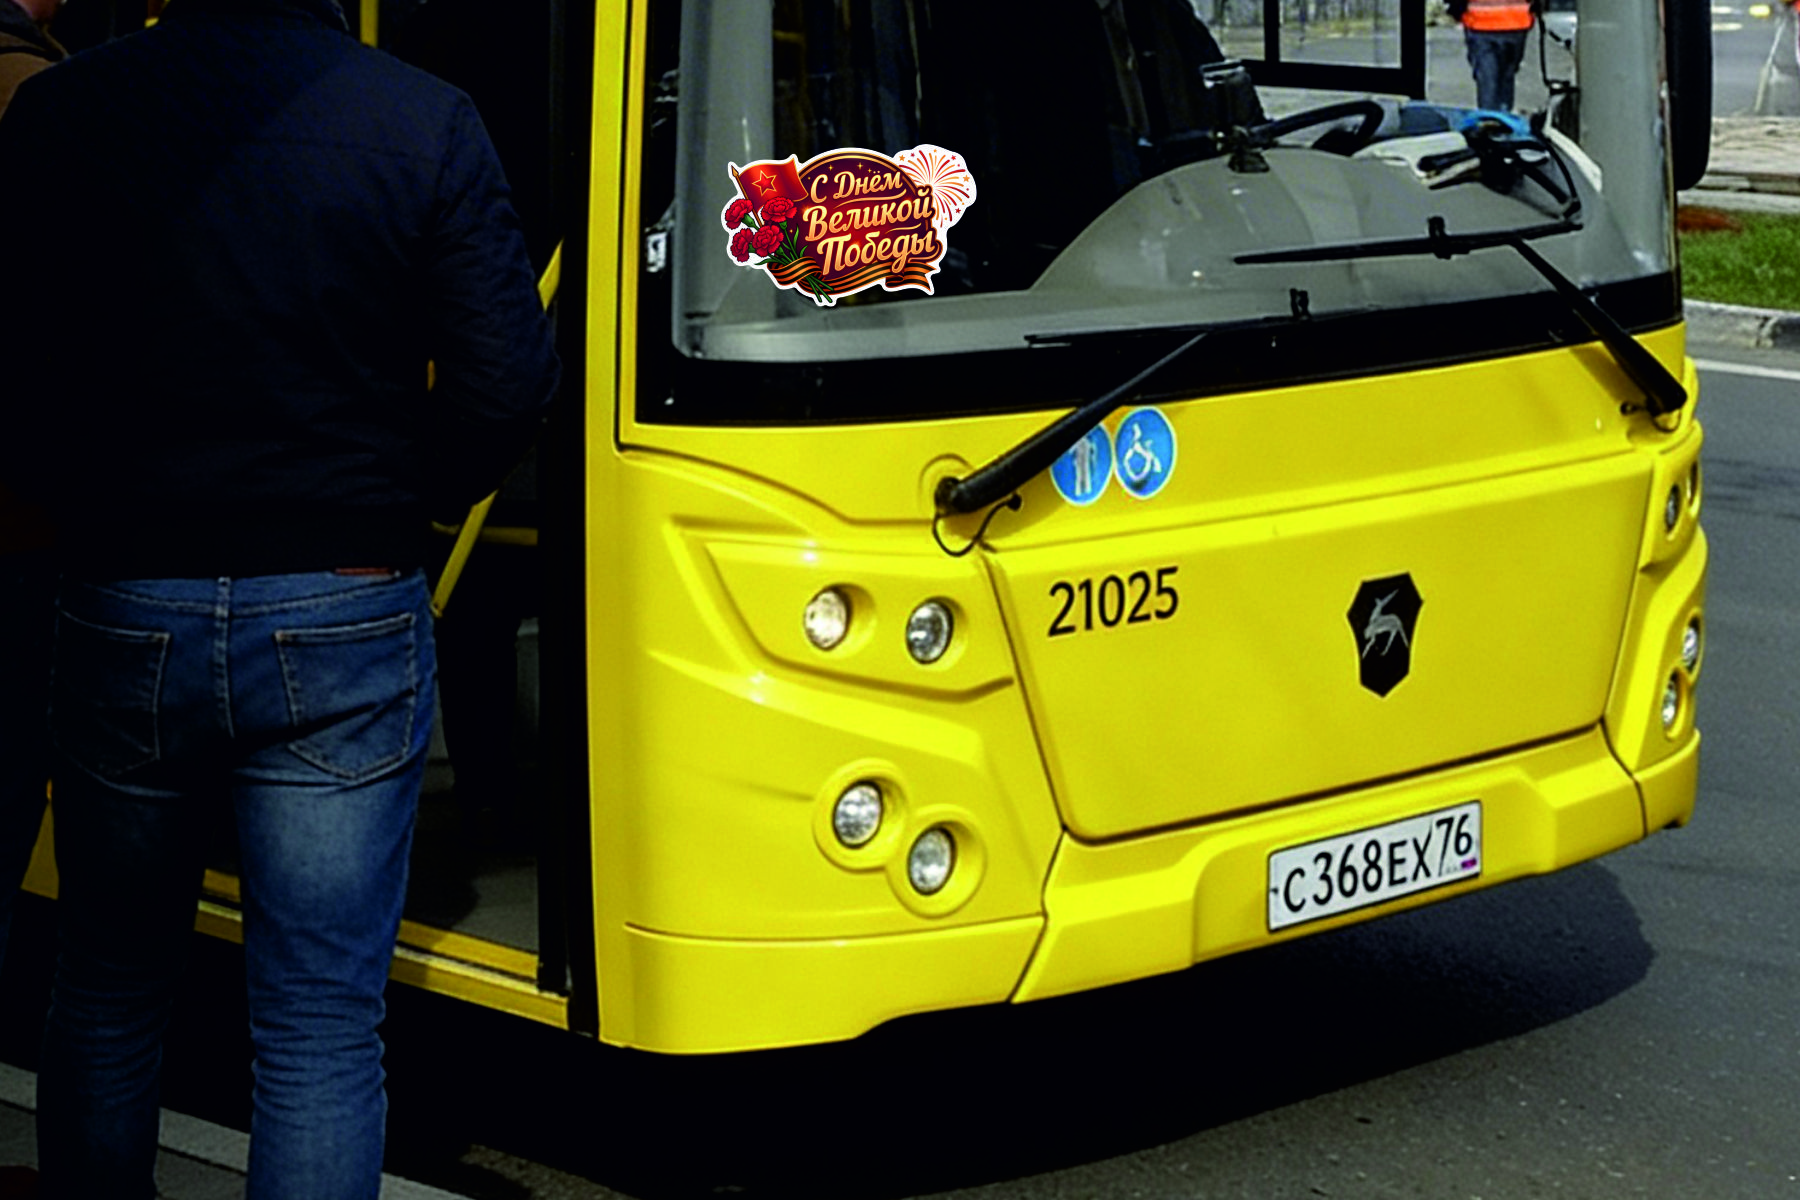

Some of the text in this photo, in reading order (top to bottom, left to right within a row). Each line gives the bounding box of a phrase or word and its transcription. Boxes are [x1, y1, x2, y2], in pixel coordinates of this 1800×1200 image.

[809, 170, 903, 203] С Днём
[802, 188, 933, 241] Великой
[816, 230, 935, 275] Победы
[1048, 566, 1179, 638] 21025
